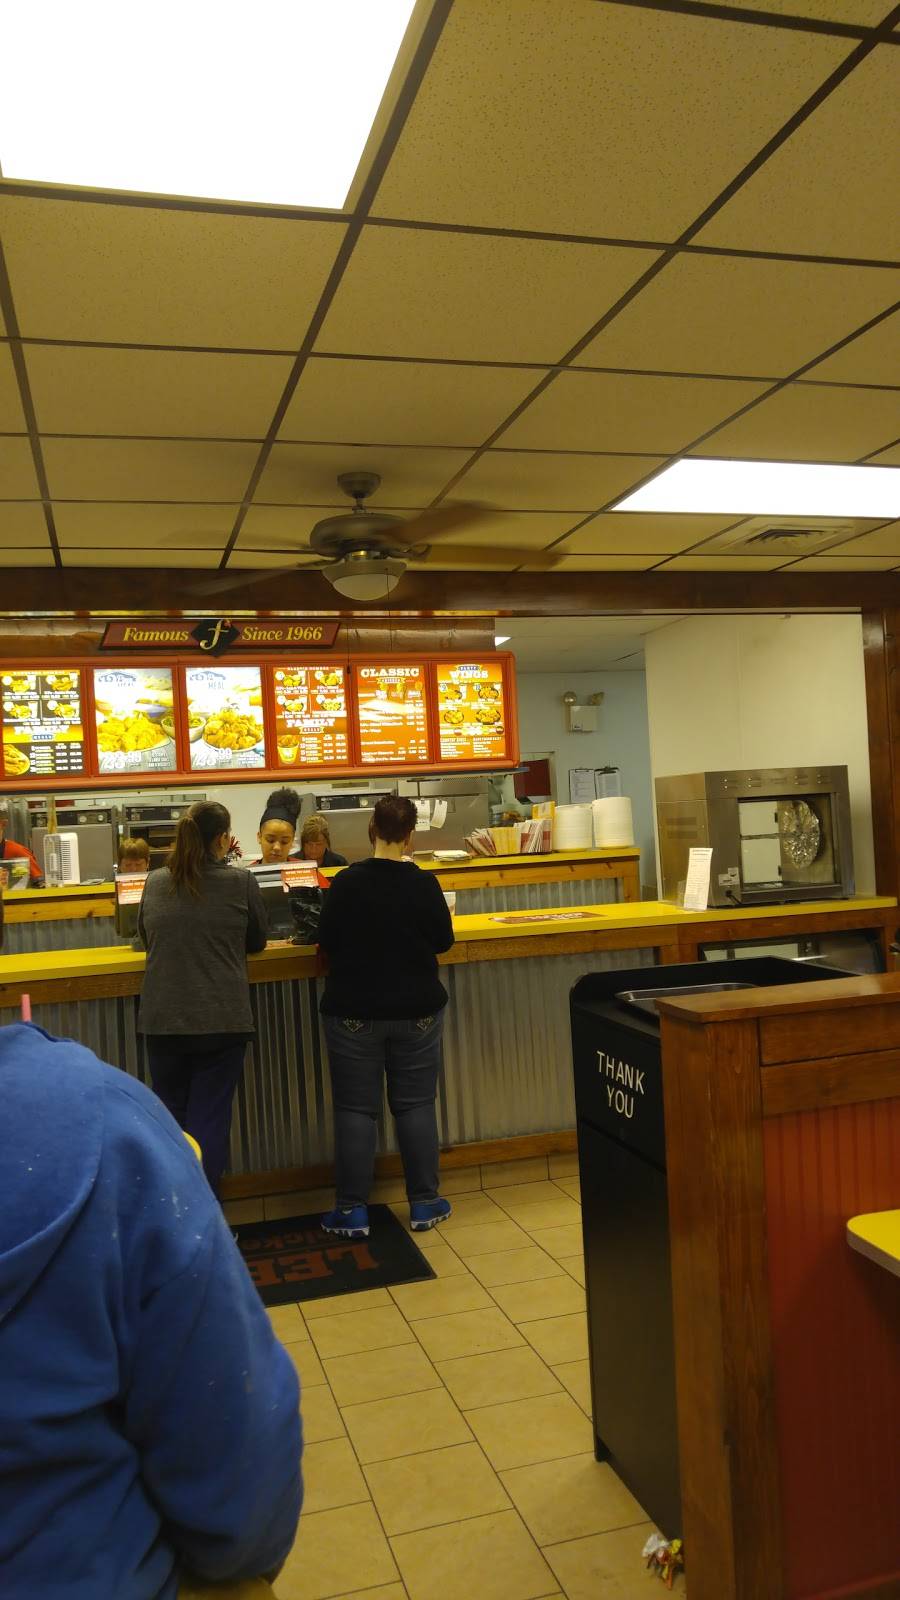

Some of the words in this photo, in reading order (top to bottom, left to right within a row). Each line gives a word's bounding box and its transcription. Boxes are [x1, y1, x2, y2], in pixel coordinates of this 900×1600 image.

[123, 627, 189, 642] Famous
[241, 626, 283, 641] Since
[286, 626, 323, 641] 1966
[360, 668, 420, 677] CLASSIC
[449, 670, 489, 679] WINGS
[286, 718, 336, 728] FAMILY
[596, 1050, 645, 1095] THANK
[607, 1084, 634, 1119] YOU
